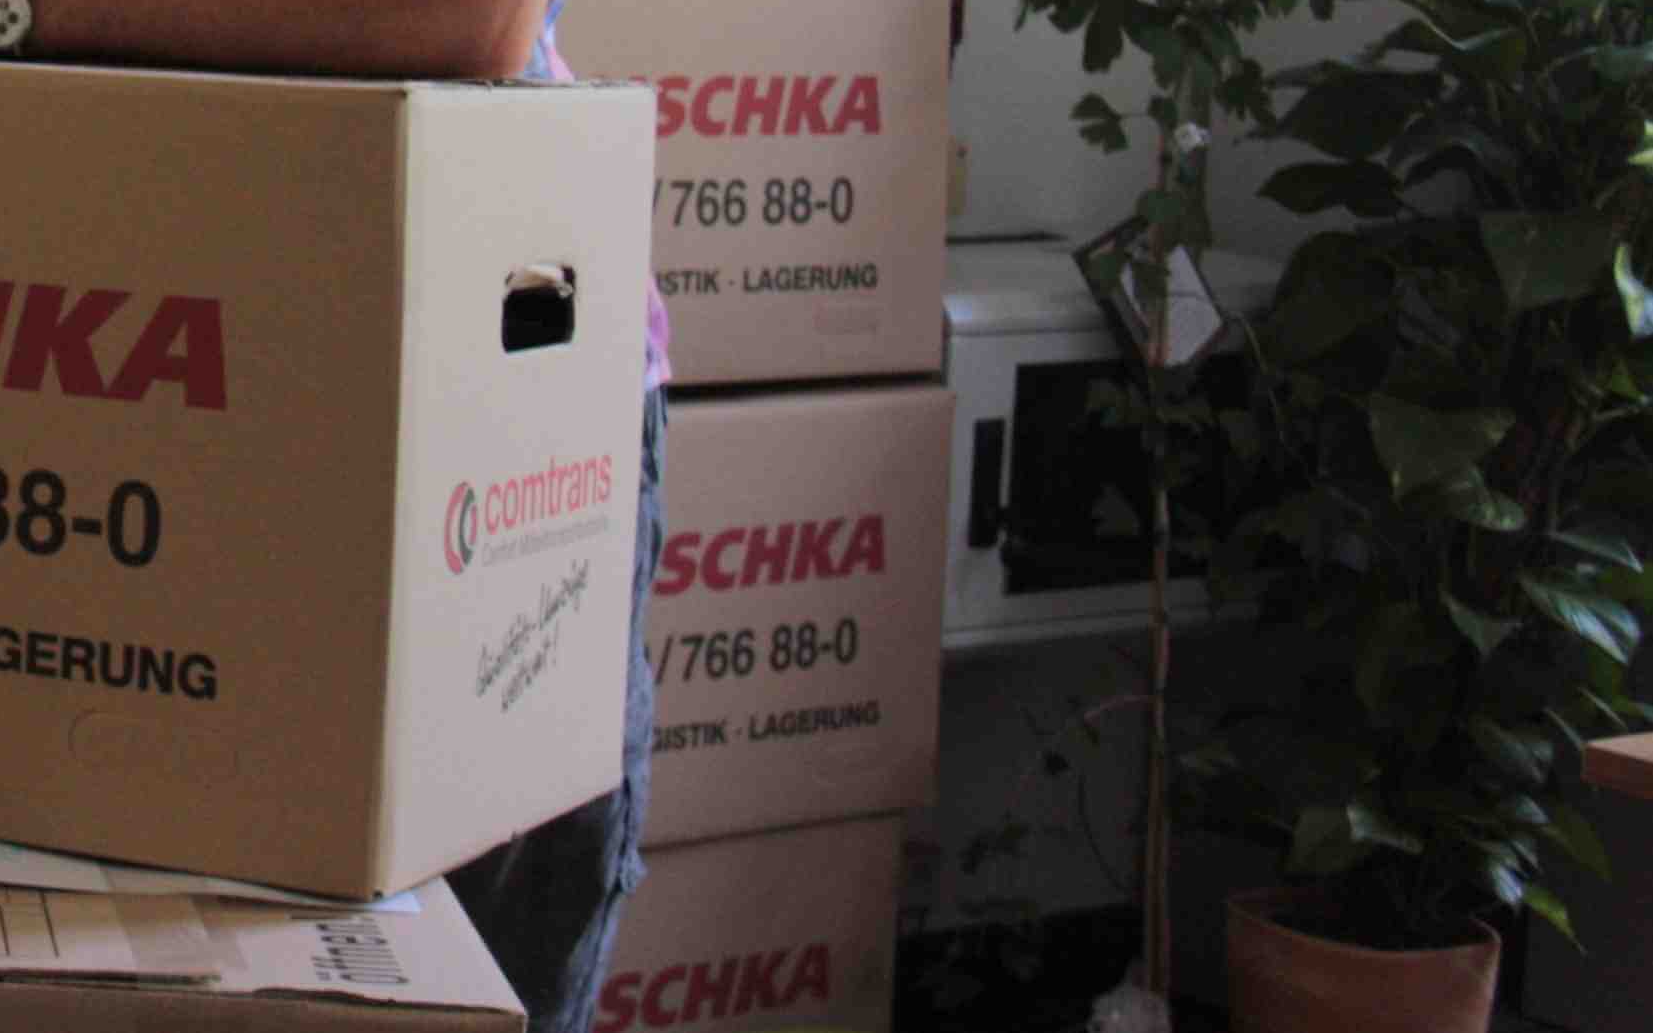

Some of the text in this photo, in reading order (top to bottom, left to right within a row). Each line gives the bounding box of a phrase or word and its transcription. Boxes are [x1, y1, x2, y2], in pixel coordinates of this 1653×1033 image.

[654, 74, 883, 137] SCHKA
[653, 177, 855, 227] /766 88-0
[742, 264, 877, 293] LAGERUNG
[484, 454, 612, 535] comtrans
[653, 514, 887, 595] SCHKA
[654, 618, 858, 686] /766 88-0
[748, 700, 882, 741] LAGERUNG
[591, 943, 830, 1033] SCHKA
